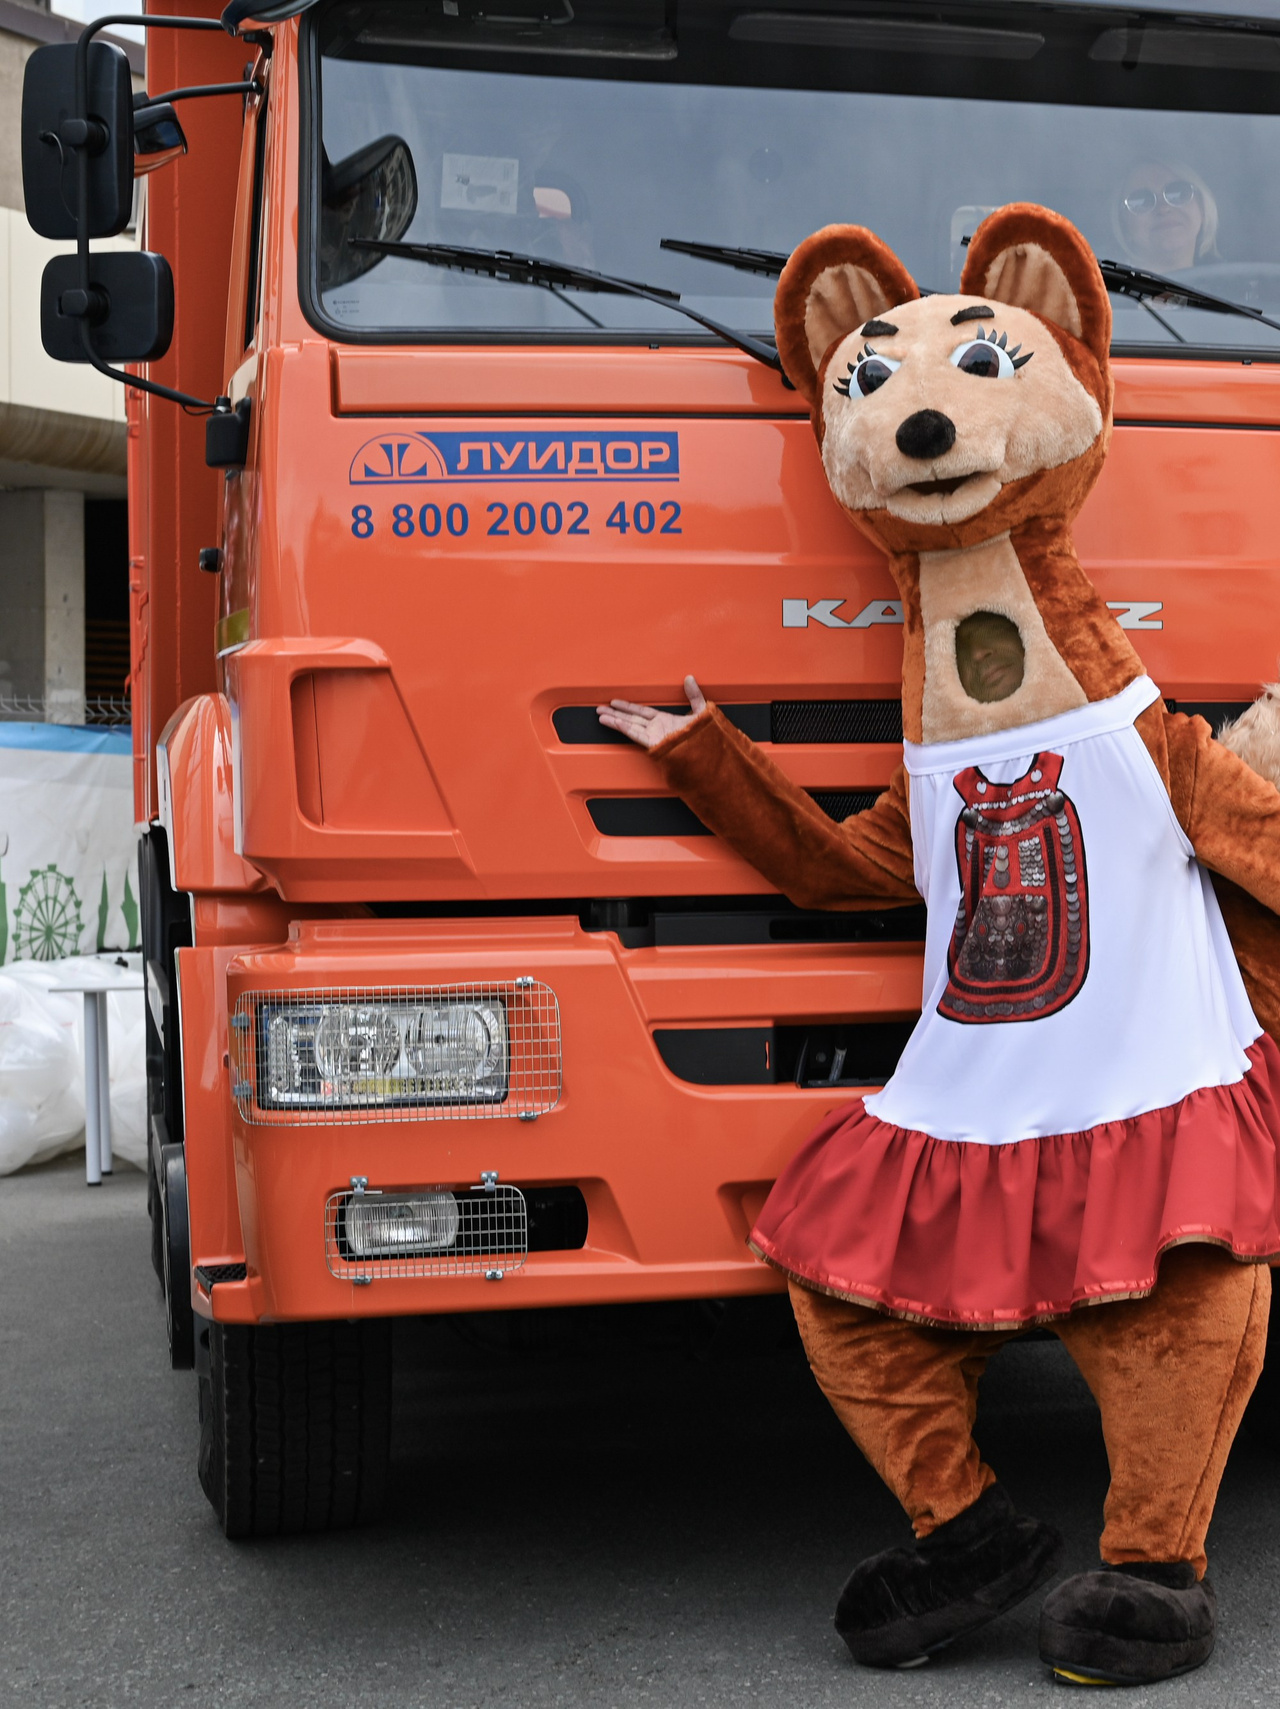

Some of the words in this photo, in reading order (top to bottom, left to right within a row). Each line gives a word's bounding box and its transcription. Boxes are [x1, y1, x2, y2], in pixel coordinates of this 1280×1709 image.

[456, 440, 671, 475] ЛУИДОР
[350, 504, 375, 539] 8
[391, 502, 470, 538] 800
[486, 501, 590, 536] 2002
[605, 500, 683, 535] 402
[781, 598, 1163, 631] KAZ
